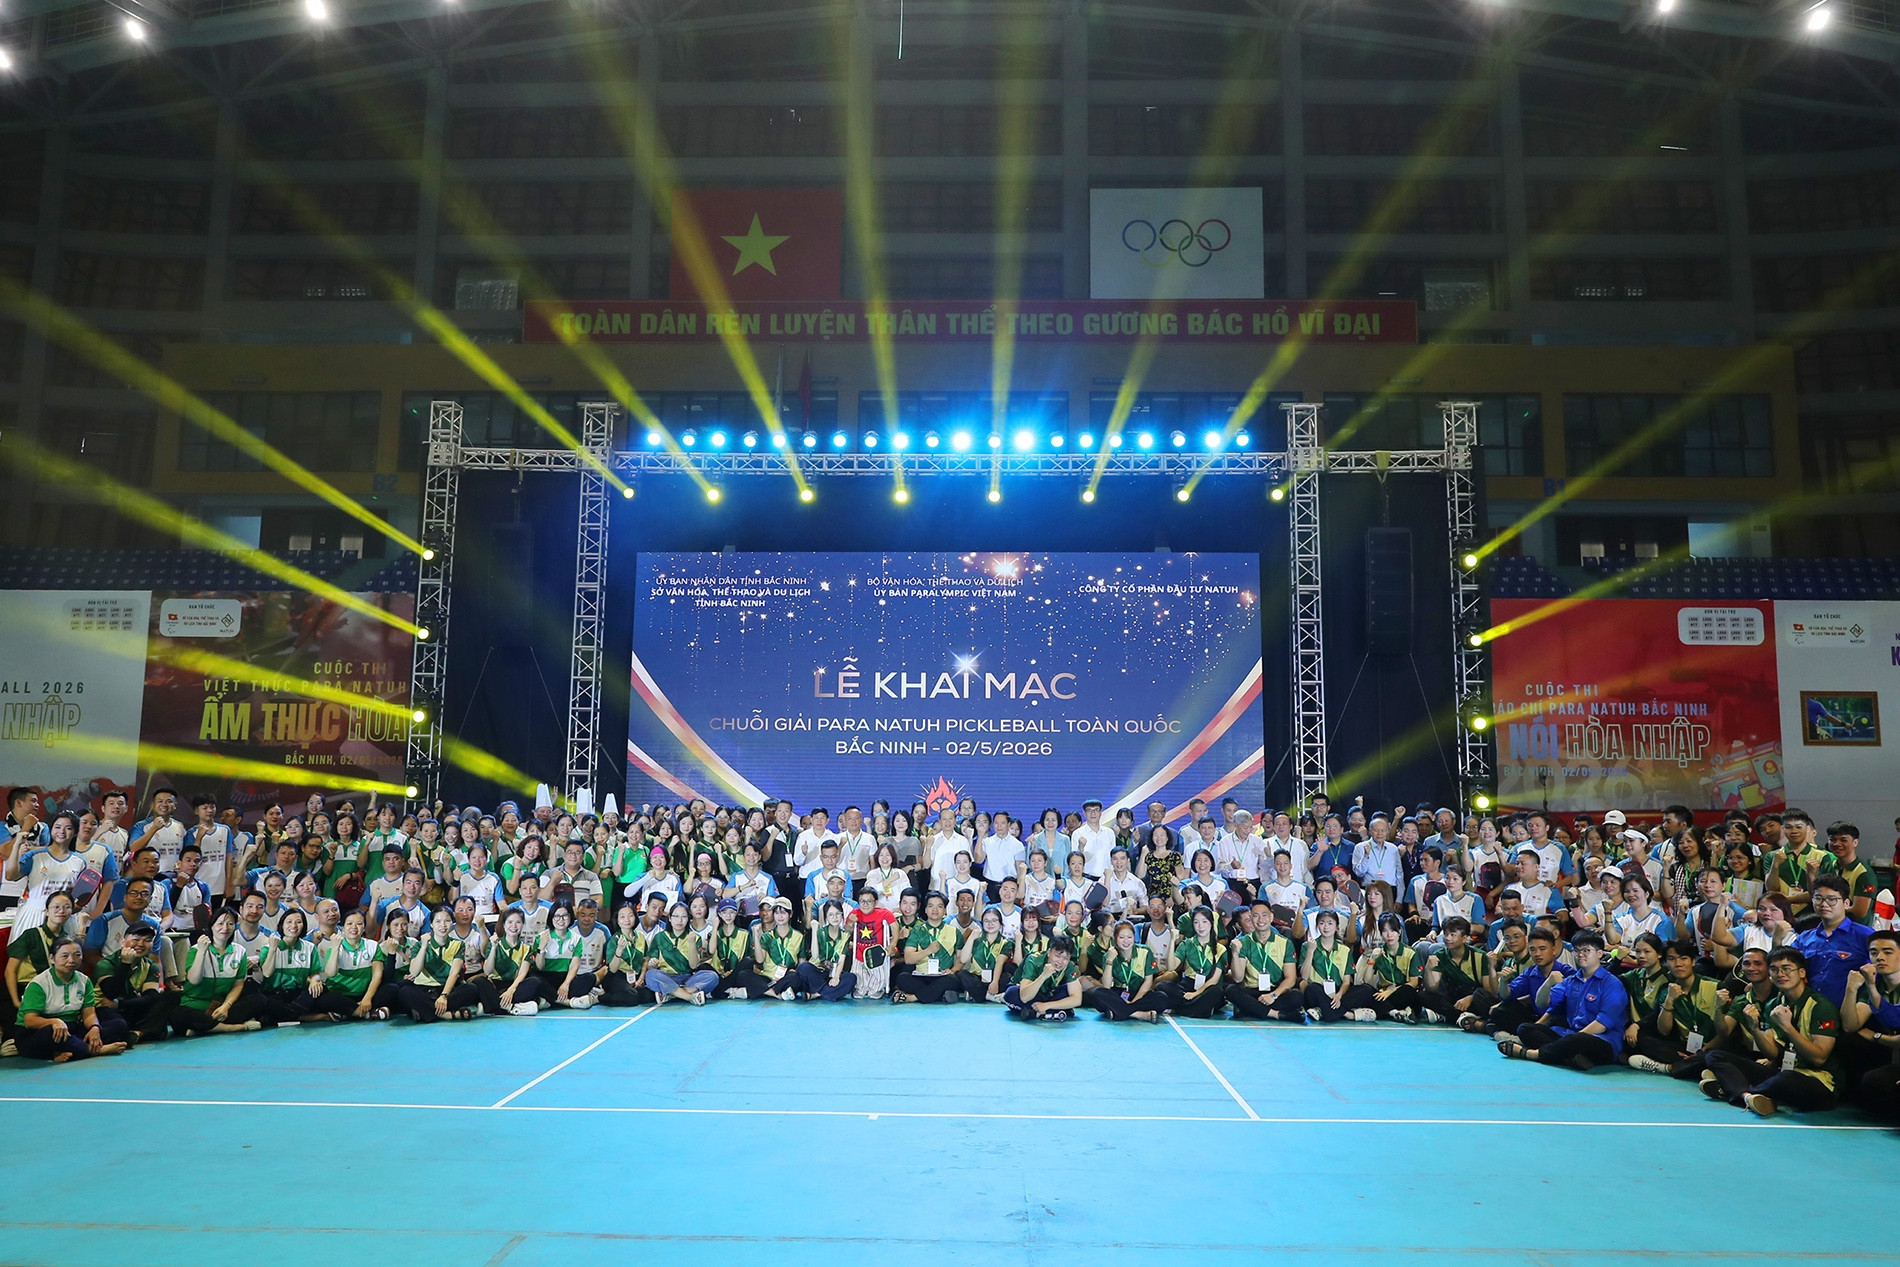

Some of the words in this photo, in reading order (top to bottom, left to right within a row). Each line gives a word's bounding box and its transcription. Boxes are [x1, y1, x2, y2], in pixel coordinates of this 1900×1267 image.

[560, 307, 630, 335] TOÀN
[640, 308, 696, 335] DÂN
[706, 308, 760, 335] RÈN
[770, 308, 856, 340] LUYỆN
[865, 308, 936, 335] THÂN
[946, 304, 997, 335] THỂ
[1006, 313, 1074, 335] THEO
[1083, 312, 1178, 335] GƯƠNG
[1188, 308, 1243, 335] BÁC
[1252, 306, 1290, 335] HỒ
[1299, 308, 1326, 335] VĨ
[1333, 313, 1381, 340] ĐẠI
[373, 474, 398, 492] B2
[719, 576, 738, 585] DÂN
[867, 577, 880, 586] BỘ
[974, 577, 986, 586] VÀ
[1079, 584, 1107, 593] CÔNG
[1138, 584, 1164, 593] PHẦN
[1166, 584, 1187, 593] ĐẦU
[651, 587, 664, 596] SỞ
[666, 587, 684, 596] VĂN
[759, 587, 772, 596] VÀ
[790, 588, 810, 598] LỊCH
[972, 588, 992, 598] VIỆT
[720, 598, 738, 607] BẮC
[314, 660, 353, 678] CUỘC
[362, 662, 388, 675] THI
[1, 682, 31, 694] ALL
[42, 682, 84, 694] 2026
[203, 677, 241, 695] VIỆT
[250, 679, 292, 696] THỰC
[301, 680, 344, 693] PARA
[352, 681, 407, 694] NATUH
[813, 657, 862, 699] LỄ
[874, 672, 970, 699] KHAI
[984, 672, 1078, 706] MẠC
[1526, 681, 1564, 700] CUỘC
[1573, 684, 1599, 696] THI
[1520, 700, 1543, 715] CHÍ
[1550, 702, 1585, 716] PARA
[1590, 702, 1637, 716] NATUH
[1642, 698, 1668, 716] BẮC
[1674, 703, 1708, 716] NINH
[2, 694, 82, 748] NHẬP
[200, 691, 251, 740] ẨM
[261, 700, 341, 750] THỰC
[348, 694, 407, 742] HÒA
[708, 709, 769, 732] CHUỖI
[773, 713, 812, 732] GIẢI
[816, 718, 871, 732] PARA
[875, 718, 941, 732] NATUH
[946, 718, 1061, 732] PICKLEBALL
[1066, 714, 1120, 733] TOÀN
[1123, 713, 1182, 736] QUỐC
[835, 735, 874, 755] BẮC
[879, 741, 928, 755] NINH
[946, 740, 1053, 756] 02/5/2026
[1508, 716, 1559, 760] NÓI
[1566, 714, 1625, 760] HÒA
[1633, 716, 1711, 768] NHẬP
[285, 751, 304, 765] BẮC
[308, 754, 336, 766] NINH,
[340, 754, 403, 766] 02/05/2026
